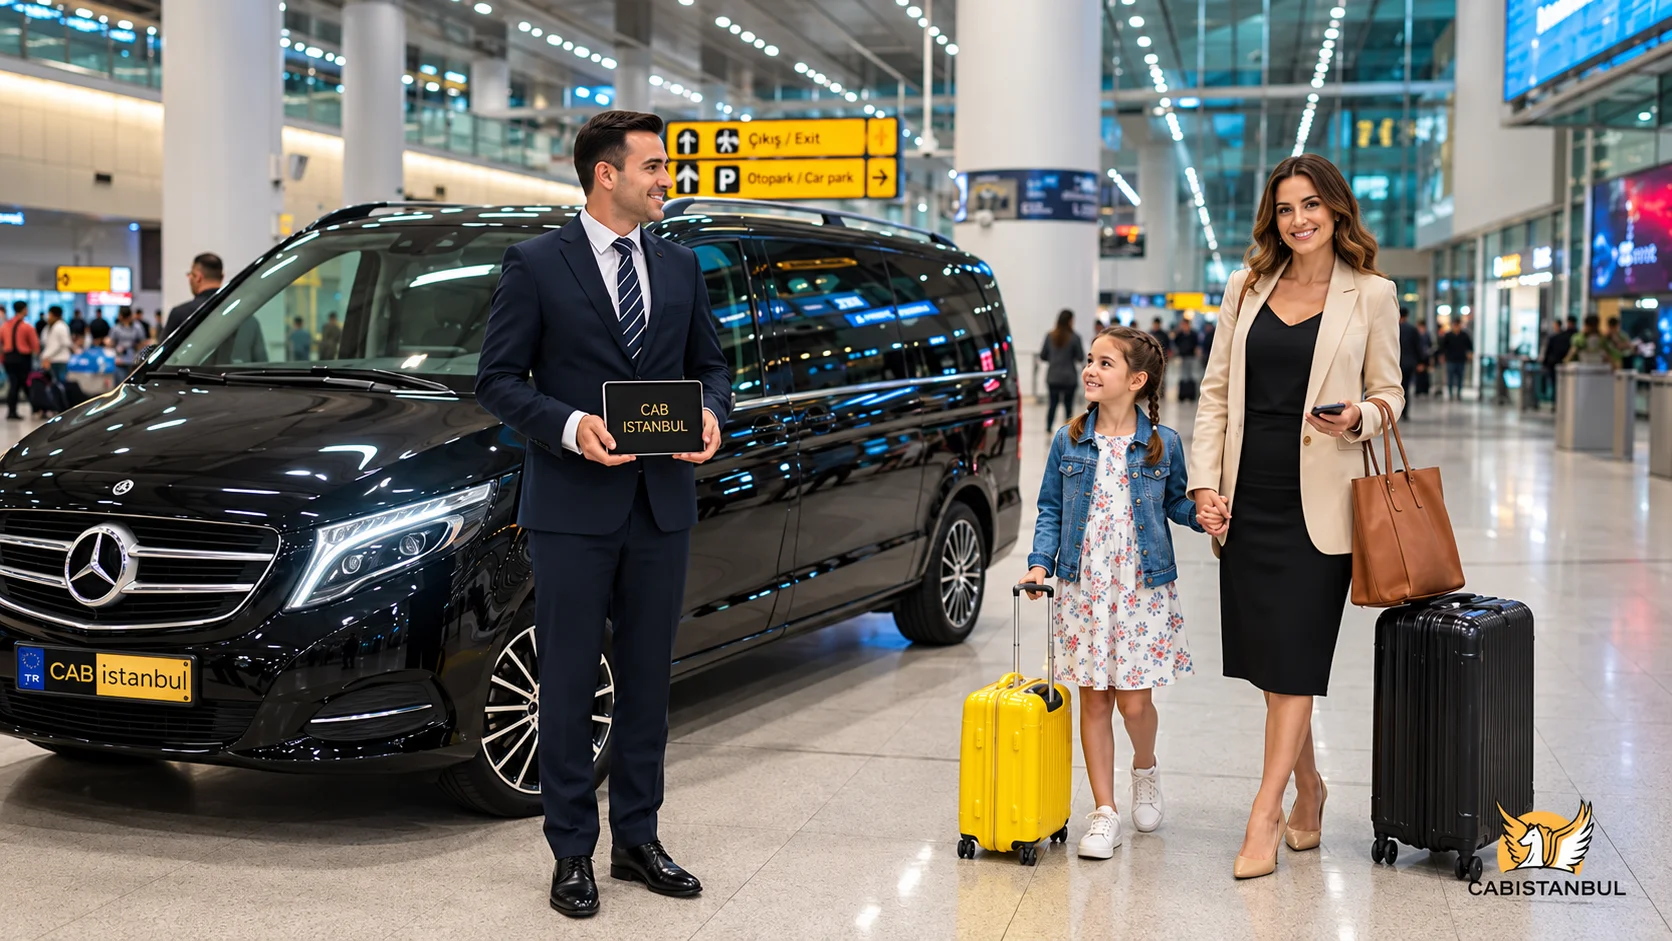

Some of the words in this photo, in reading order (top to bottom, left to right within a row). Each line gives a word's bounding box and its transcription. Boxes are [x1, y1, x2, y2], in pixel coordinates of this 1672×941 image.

[748, 132, 781, 149] Çıkış
[795, 132, 820, 145] Exit
[719, 168, 736, 192] P
[747, 171, 793, 186] Otopark
[804, 171, 824, 184] Car
[828, 171, 853, 186] park
[640, 403, 669, 416] CAB
[623, 420, 688, 433] ISTANBUL
[24, 673, 40, 683] TR
[49, 661, 94, 683] CAB
[102, 663, 187, 690] istanbul
